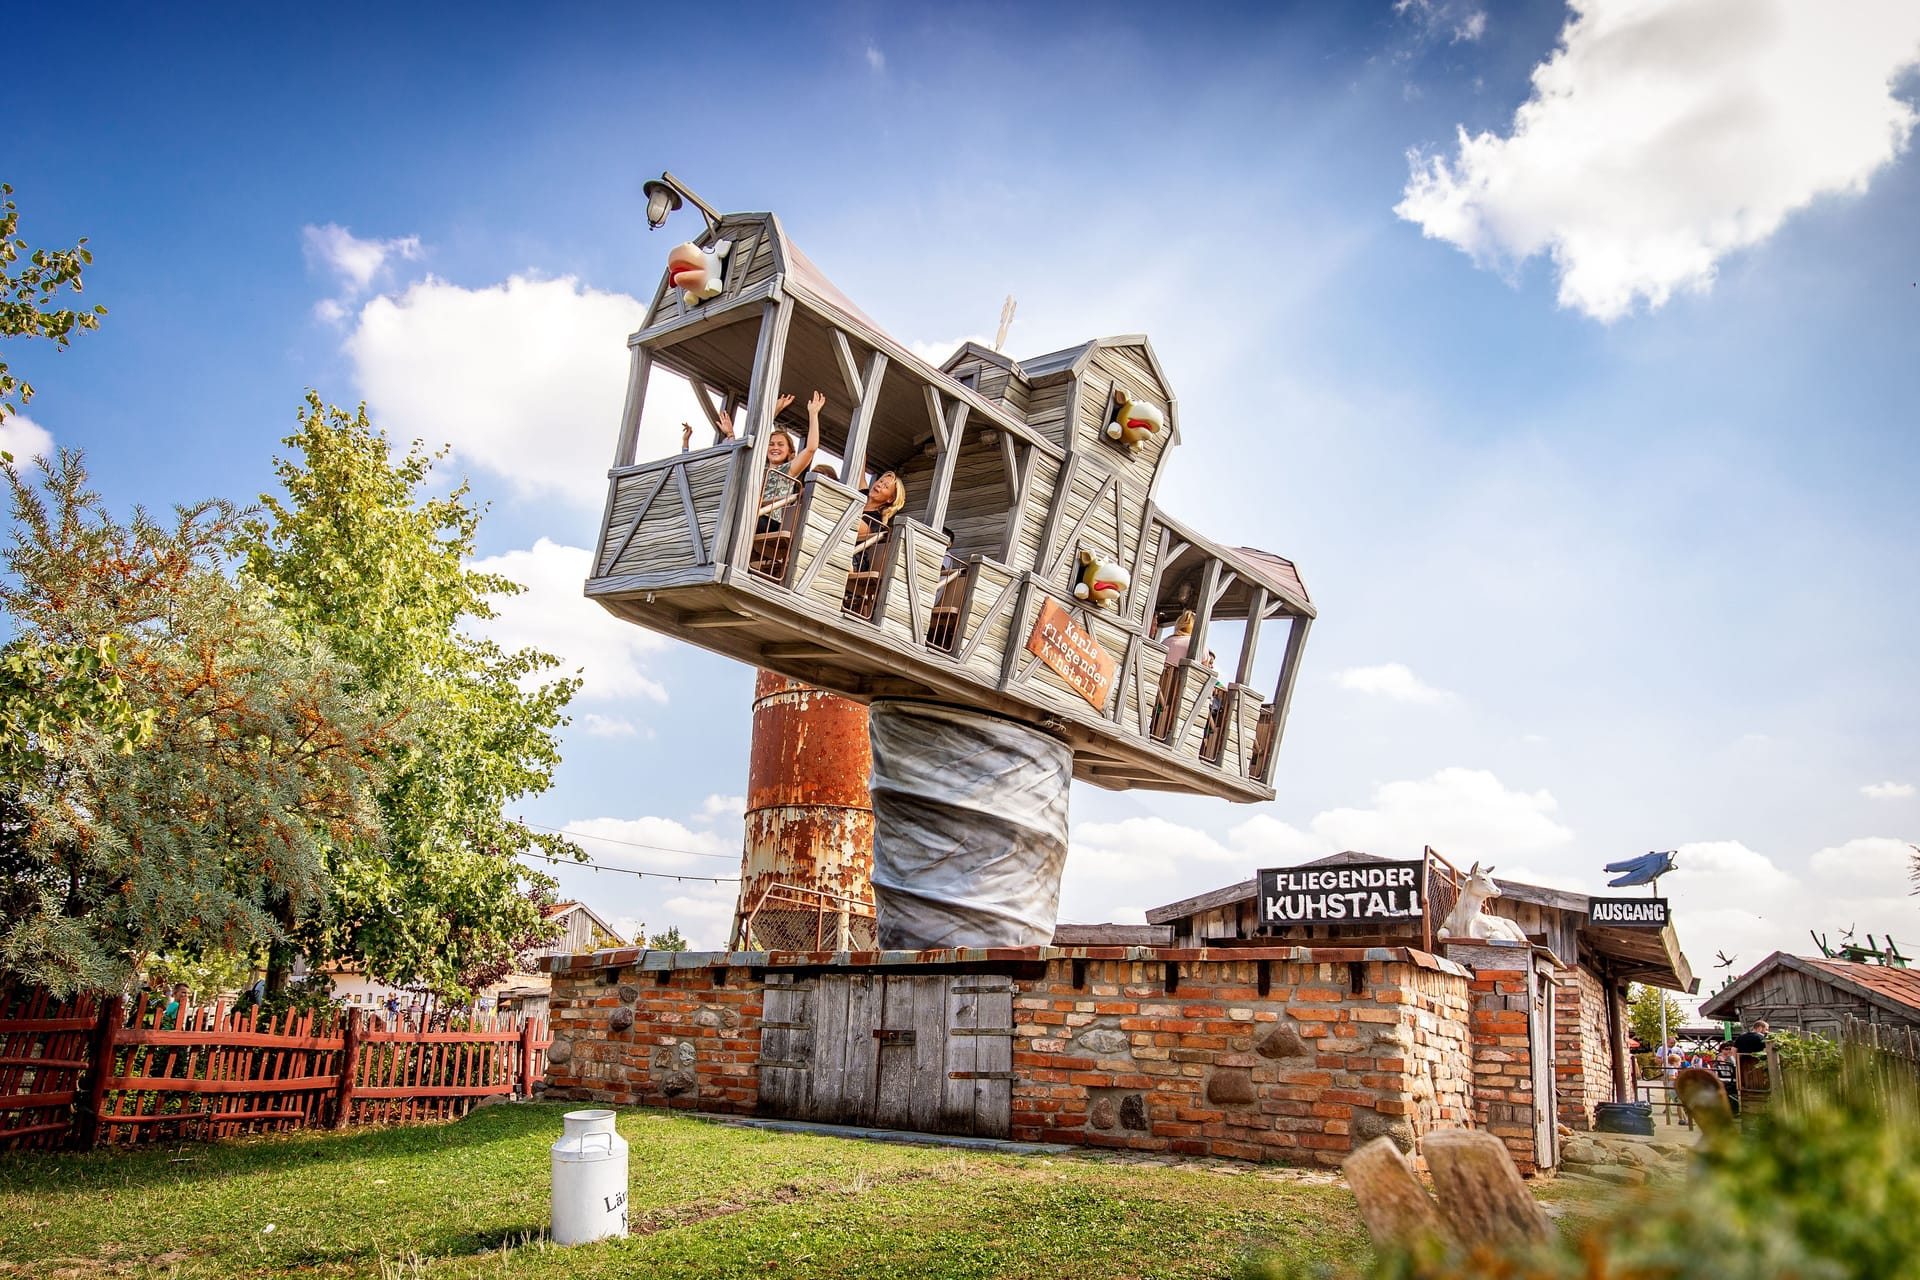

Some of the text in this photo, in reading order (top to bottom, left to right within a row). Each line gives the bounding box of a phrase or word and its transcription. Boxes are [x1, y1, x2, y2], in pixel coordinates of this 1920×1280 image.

[1042, 623, 1108, 687] fliegender
[1064, 621, 1098, 660] Karls
[1276, 868, 1415, 892] FLIEGENDER
[1266, 890, 1423, 920] KUHSTALL
[1592, 903, 1665, 922] AUSGANG
